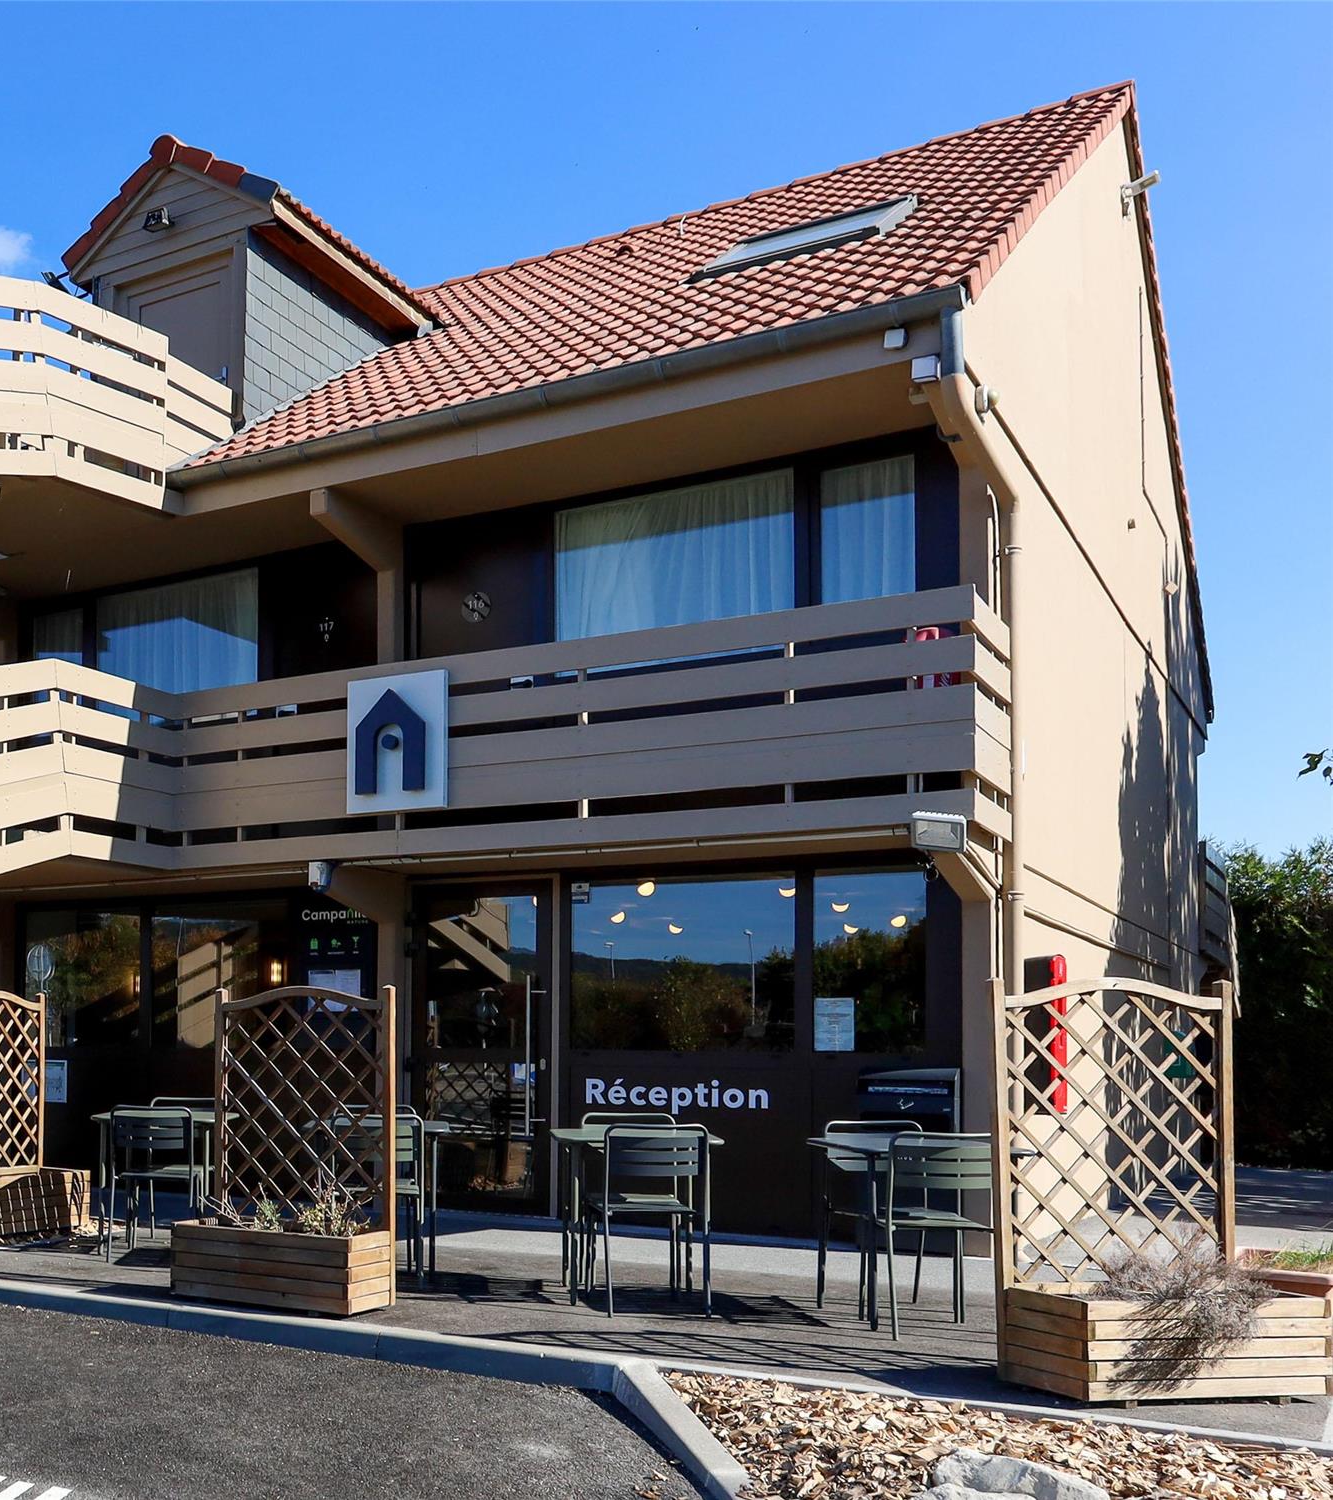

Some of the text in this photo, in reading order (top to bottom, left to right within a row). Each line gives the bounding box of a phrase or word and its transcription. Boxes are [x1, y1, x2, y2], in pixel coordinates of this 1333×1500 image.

[468, 600, 485, 609] 116
[319, 621, 334, 632] 117
[585, 1077, 769, 1115] Réception
